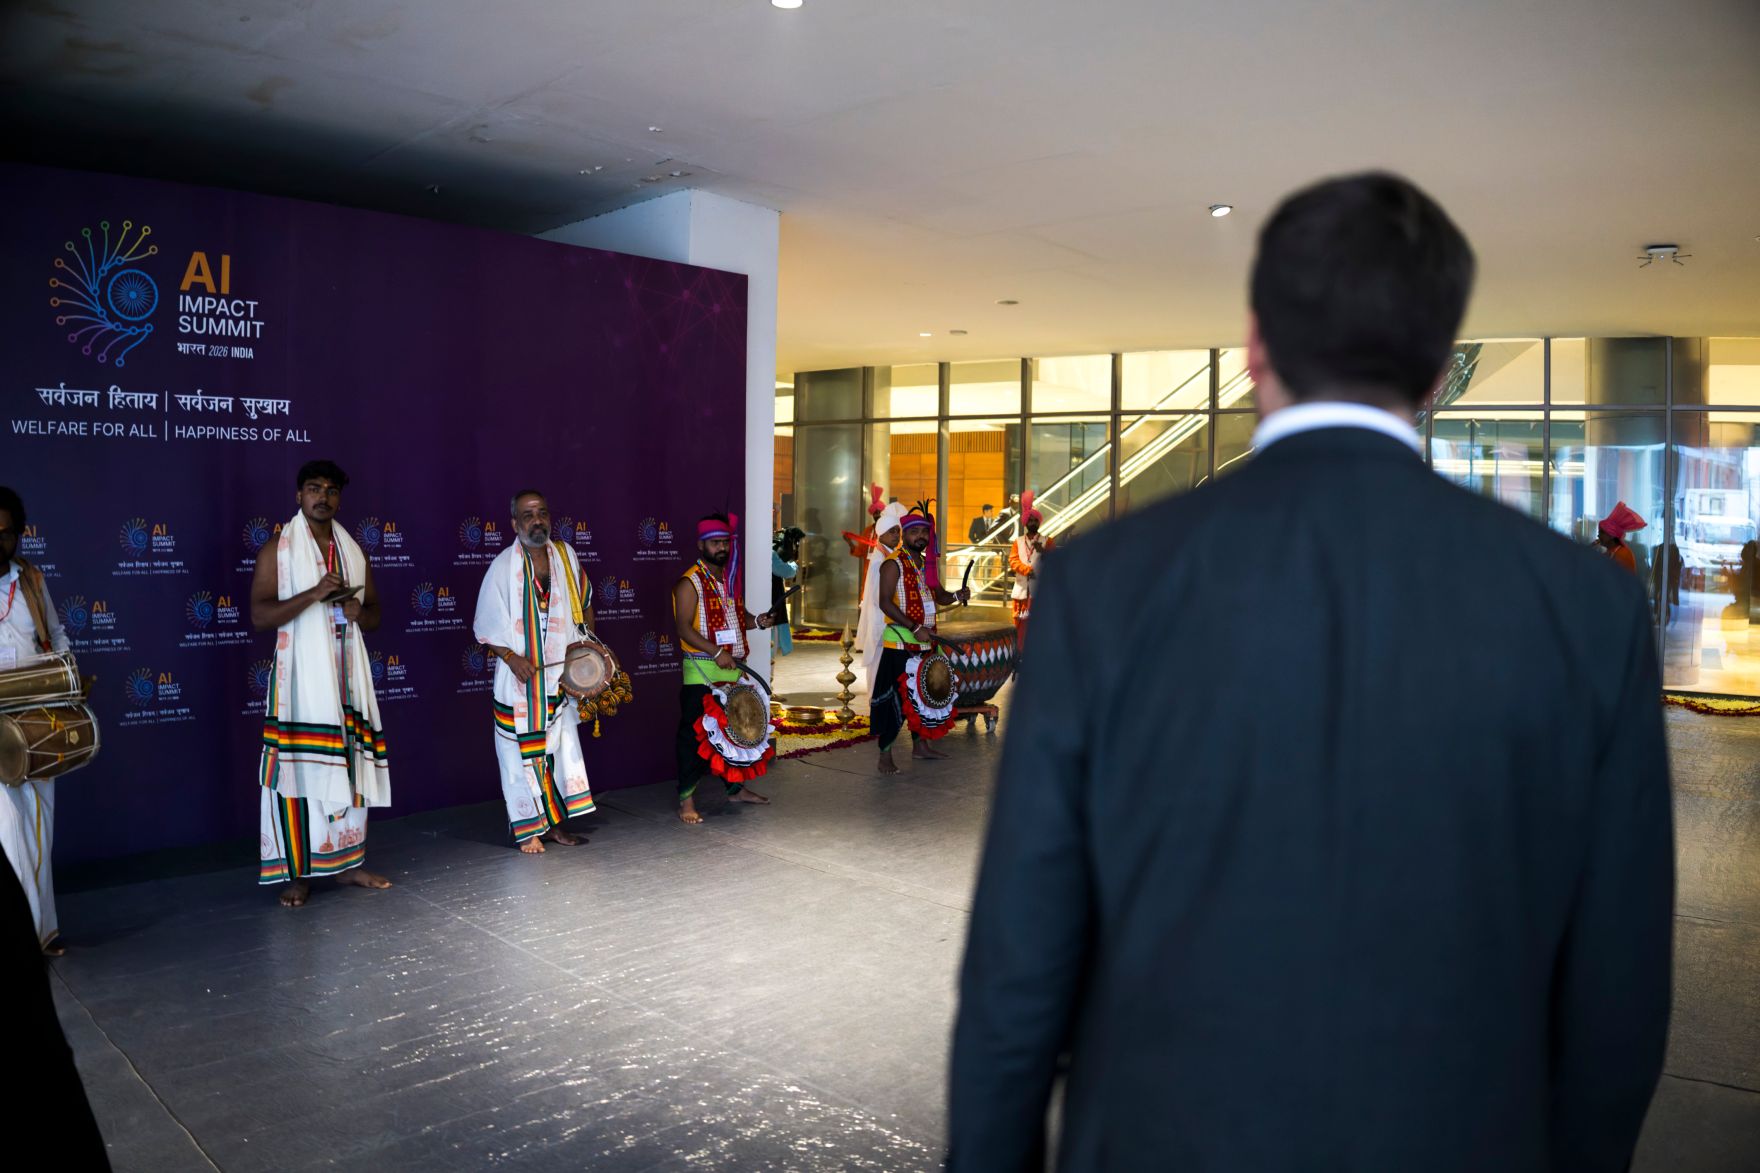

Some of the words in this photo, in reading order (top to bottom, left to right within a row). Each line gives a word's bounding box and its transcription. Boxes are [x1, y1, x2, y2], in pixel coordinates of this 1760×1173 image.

[180, 251, 231, 295] AI
[179, 294, 259, 318] IMPACT
[178, 315, 264, 339] SUMMIT
[177, 342, 206, 355] भारत
[208, 345, 229, 357] 2026
[231, 346, 254, 359] INDIA
[34, 383, 100, 408] सर्वजन
[107, 385, 159, 410] हिताय
[174, 389, 235, 413] सर्वजन
[239, 397, 291, 420] सुखाय
[12, 420, 88, 436] WELFARE
[93, 422, 125, 437] FOR
[129, 424, 157, 438] ALL
[175, 425, 258, 441] HAPPINESS
[262, 428, 282, 441] OF
[286, 429, 311, 442] ALL
[22, 525, 37, 537] AI
[152, 523, 167, 535] AI
[384, 522, 396, 532] AI
[484, 521, 496, 531] AI
[576, 521, 586, 531] AI
[659, 521, 668, 531] AI
[619, 579, 629, 589] AI
[438, 586, 449, 597] AI
[92, 600, 107, 612] AI
[217, 595, 231, 607] AI
[660, 635, 669, 643] AI
[388, 655, 399, 665] AI
[158, 672, 172, 684] AI
